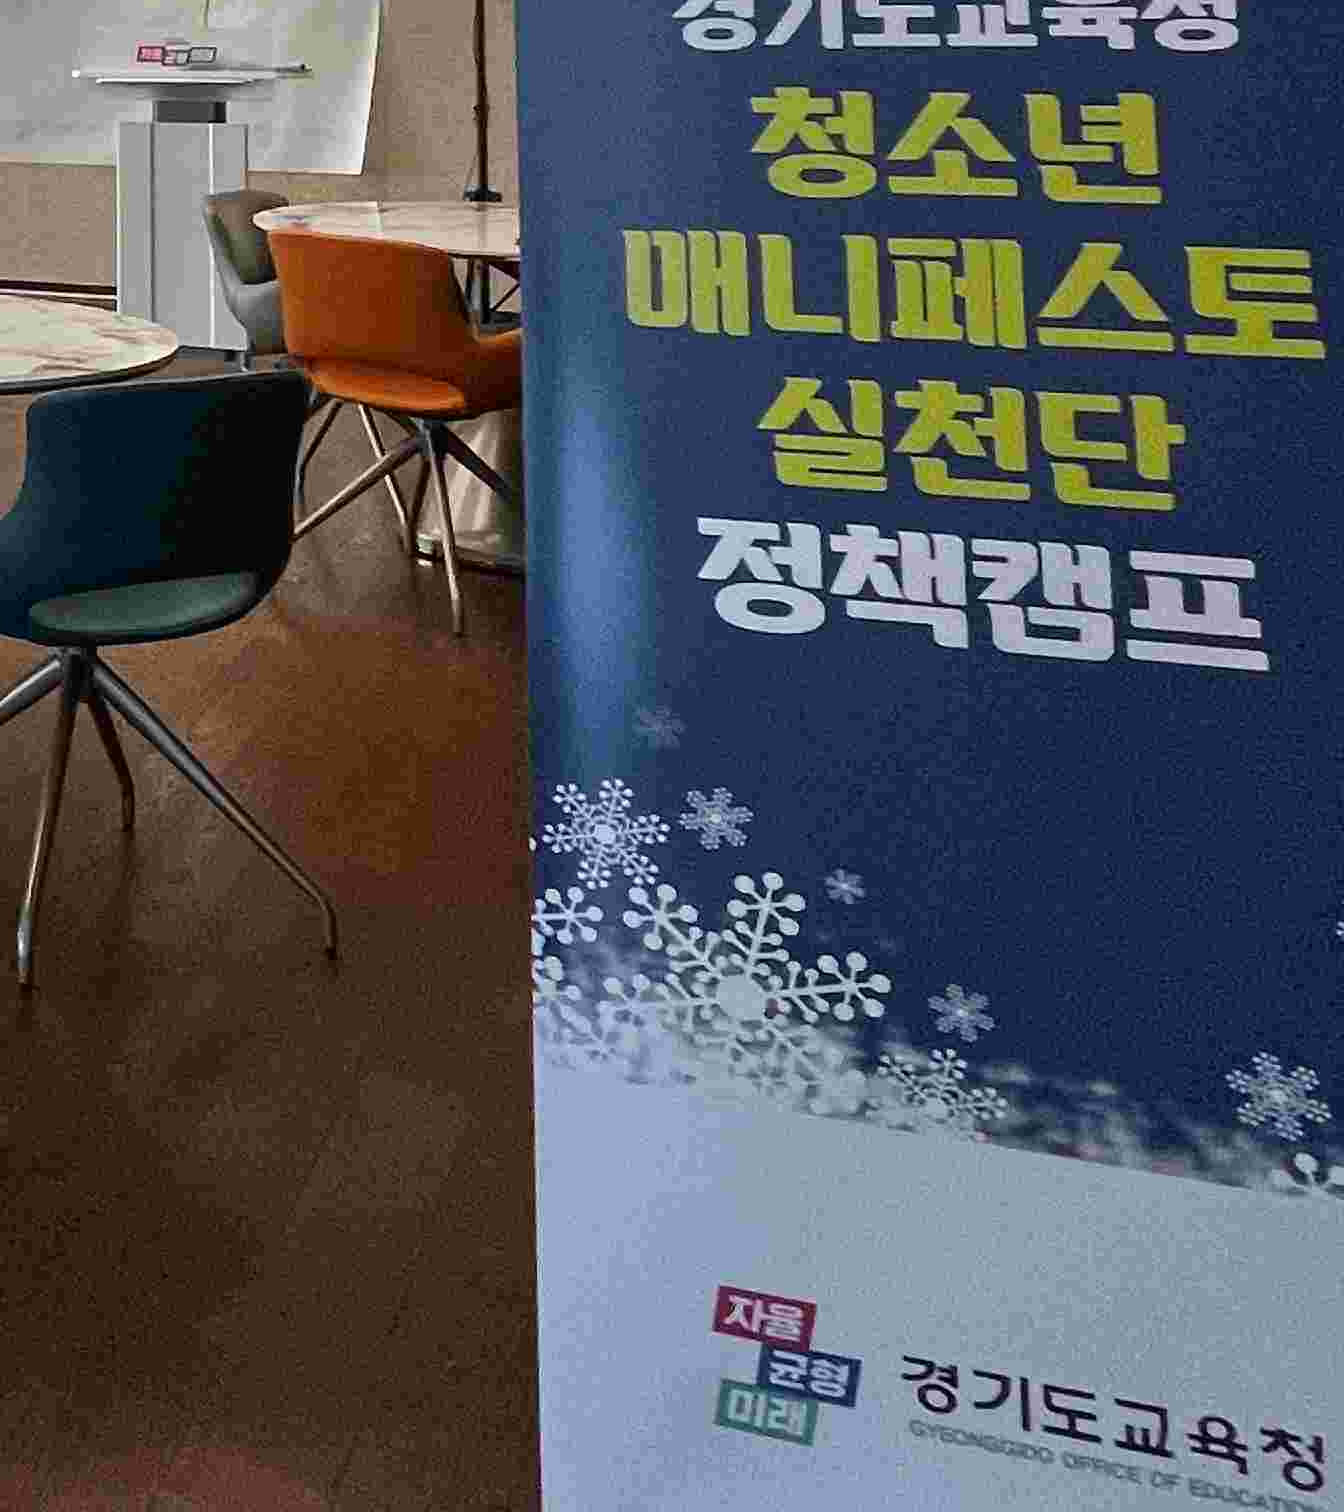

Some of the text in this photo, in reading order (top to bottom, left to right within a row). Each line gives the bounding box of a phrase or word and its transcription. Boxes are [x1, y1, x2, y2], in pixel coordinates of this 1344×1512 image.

[749, 84, 1163, 206] 청소년
[621, 227, 1328, 361] 매니페스토
[756, 375, 1188, 513] 실천단
[695, 515, 1272, 673] 정책캠프
[723, 1294, 804, 1342] 자율
[768, 1349, 849, 1398] 균형
[726, 1388, 809, 1436] 미래
[900, 1354, 1325, 1493] 경기도교육청
[1152, 1470, 1181, 1489] OF
